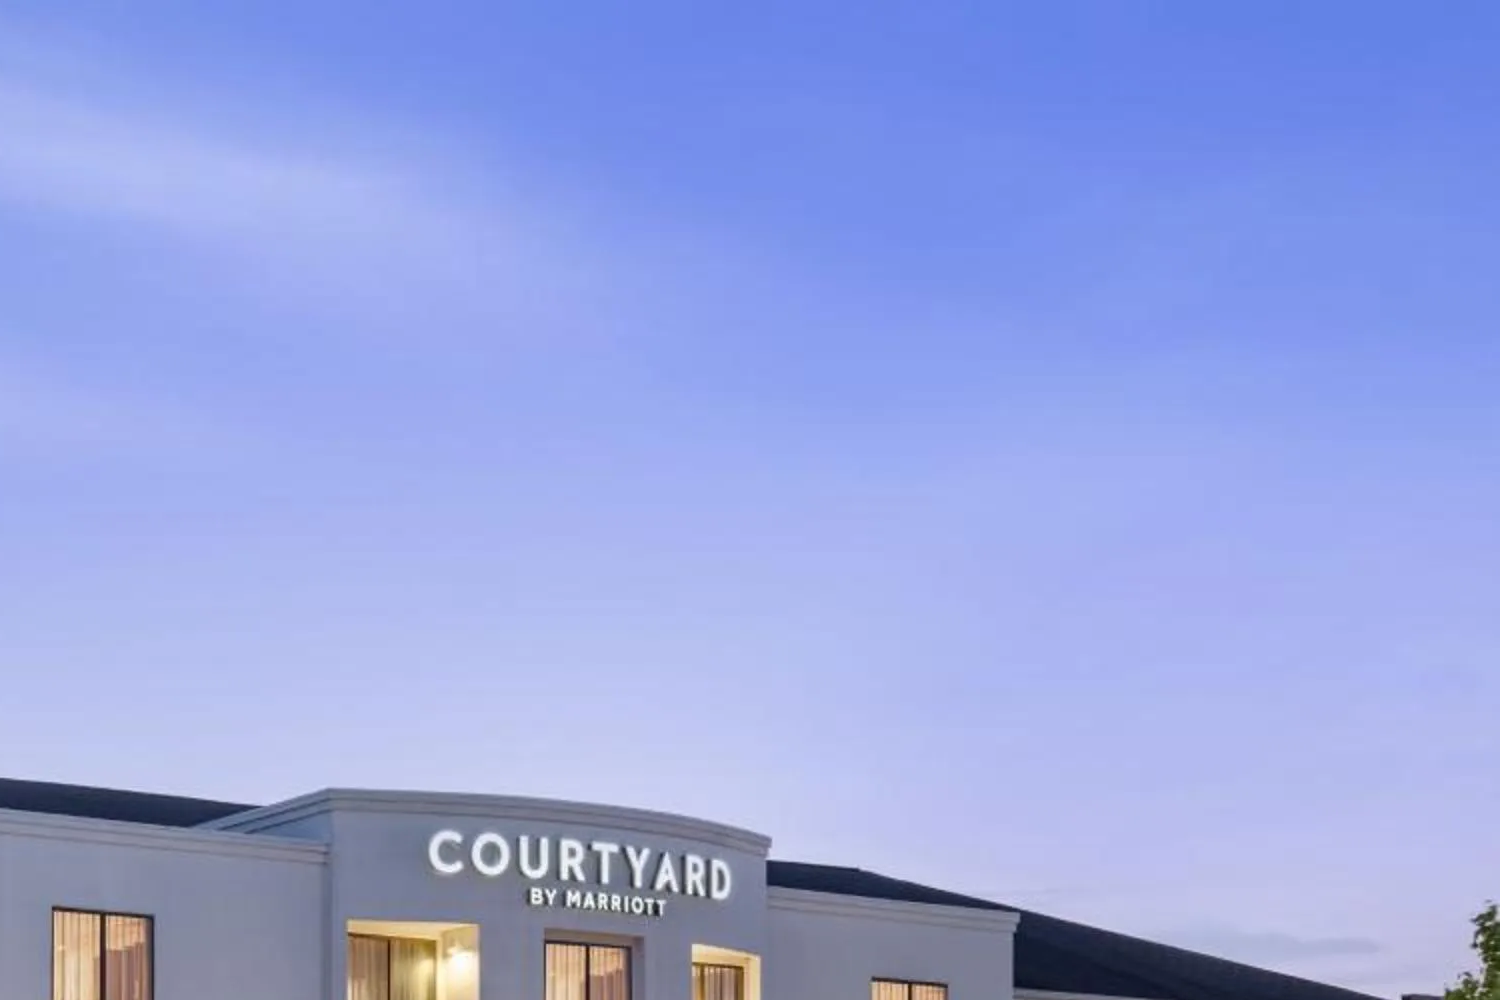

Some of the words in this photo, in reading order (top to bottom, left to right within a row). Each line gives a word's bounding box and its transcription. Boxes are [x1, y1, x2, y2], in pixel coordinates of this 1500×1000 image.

[428, 829, 732, 900] COURTYARD
[529, 887, 558, 906] BY
[566, 890, 668, 917] MARRIOTT
